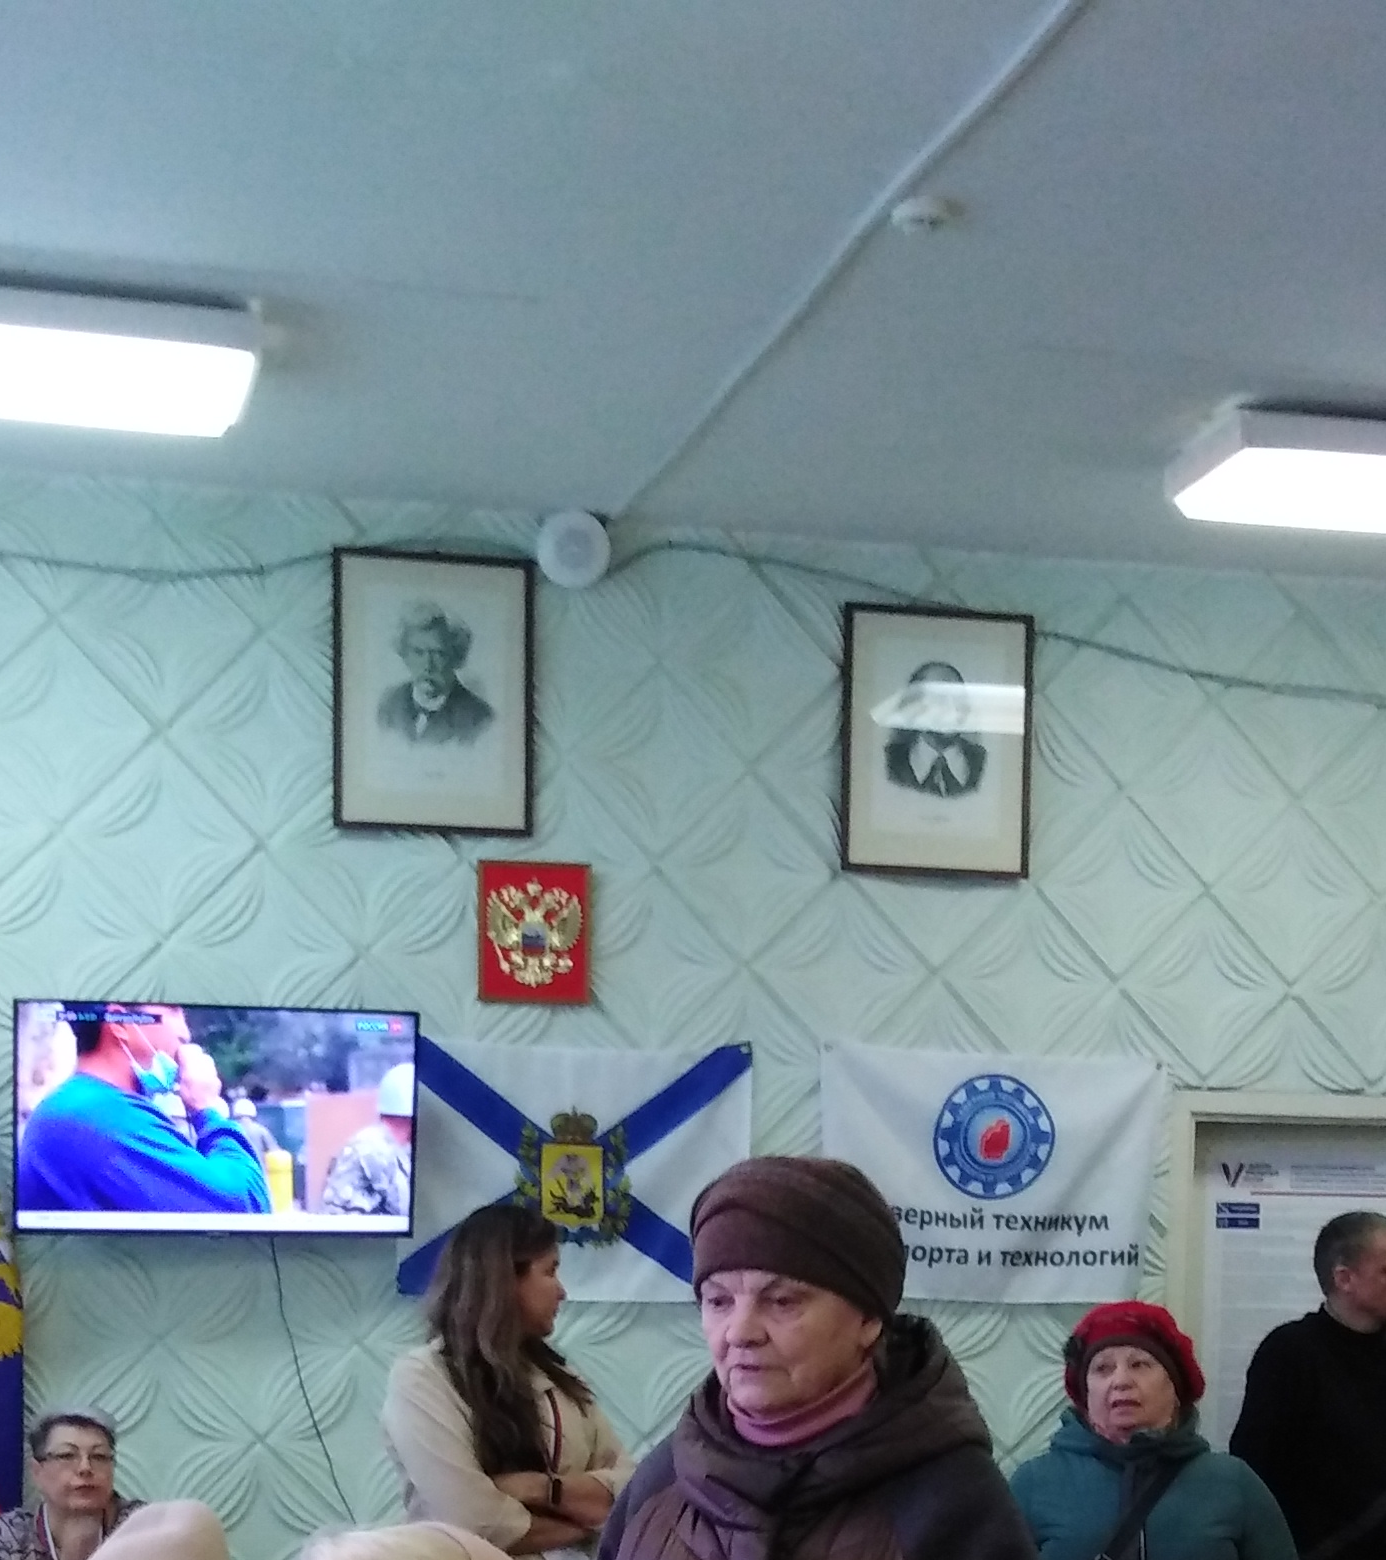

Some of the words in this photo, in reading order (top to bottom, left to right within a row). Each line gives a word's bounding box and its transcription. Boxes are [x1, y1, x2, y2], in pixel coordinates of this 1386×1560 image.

[893, 1204, 985, 1230] верный
[992, 1213, 1110, 1236] техникум
[977, 1250, 991, 1266] и
[1000, 1243, 1140, 1268] технологий
